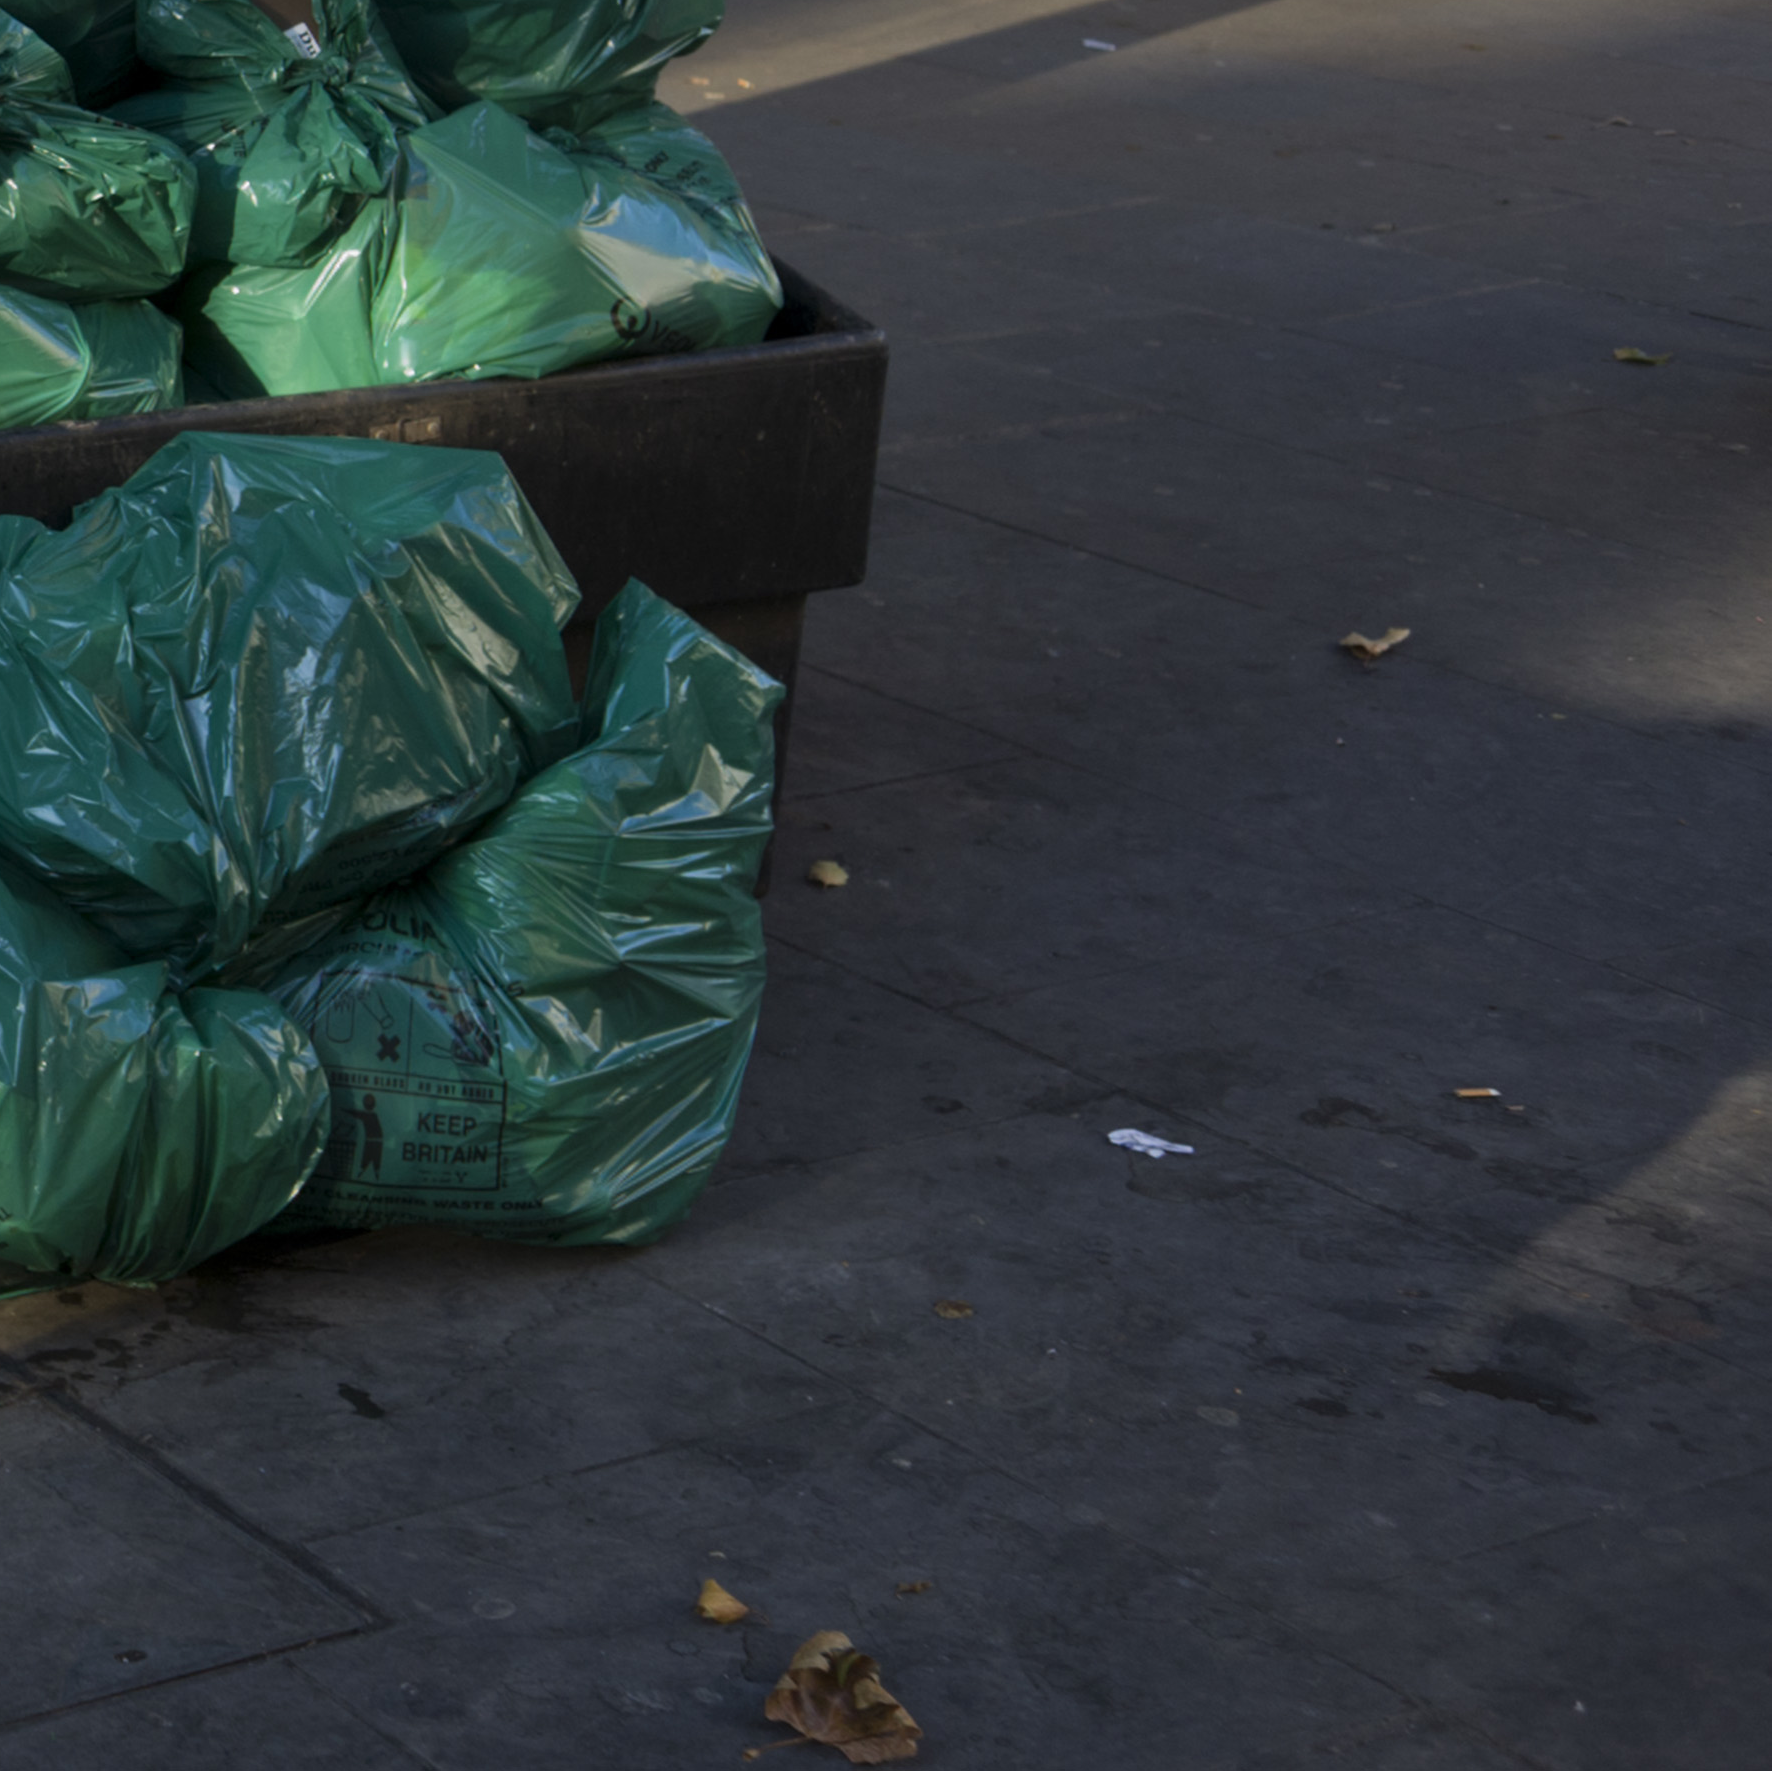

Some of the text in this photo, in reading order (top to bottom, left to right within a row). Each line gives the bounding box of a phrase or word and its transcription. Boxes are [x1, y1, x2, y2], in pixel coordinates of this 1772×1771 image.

[417, 1112, 478, 1137] KEEP
[401, 1141, 488, 1164] BRITAIN
[433, 1199, 495, 1211] WASTE
[500, 1200, 544, 1211] ONLY
